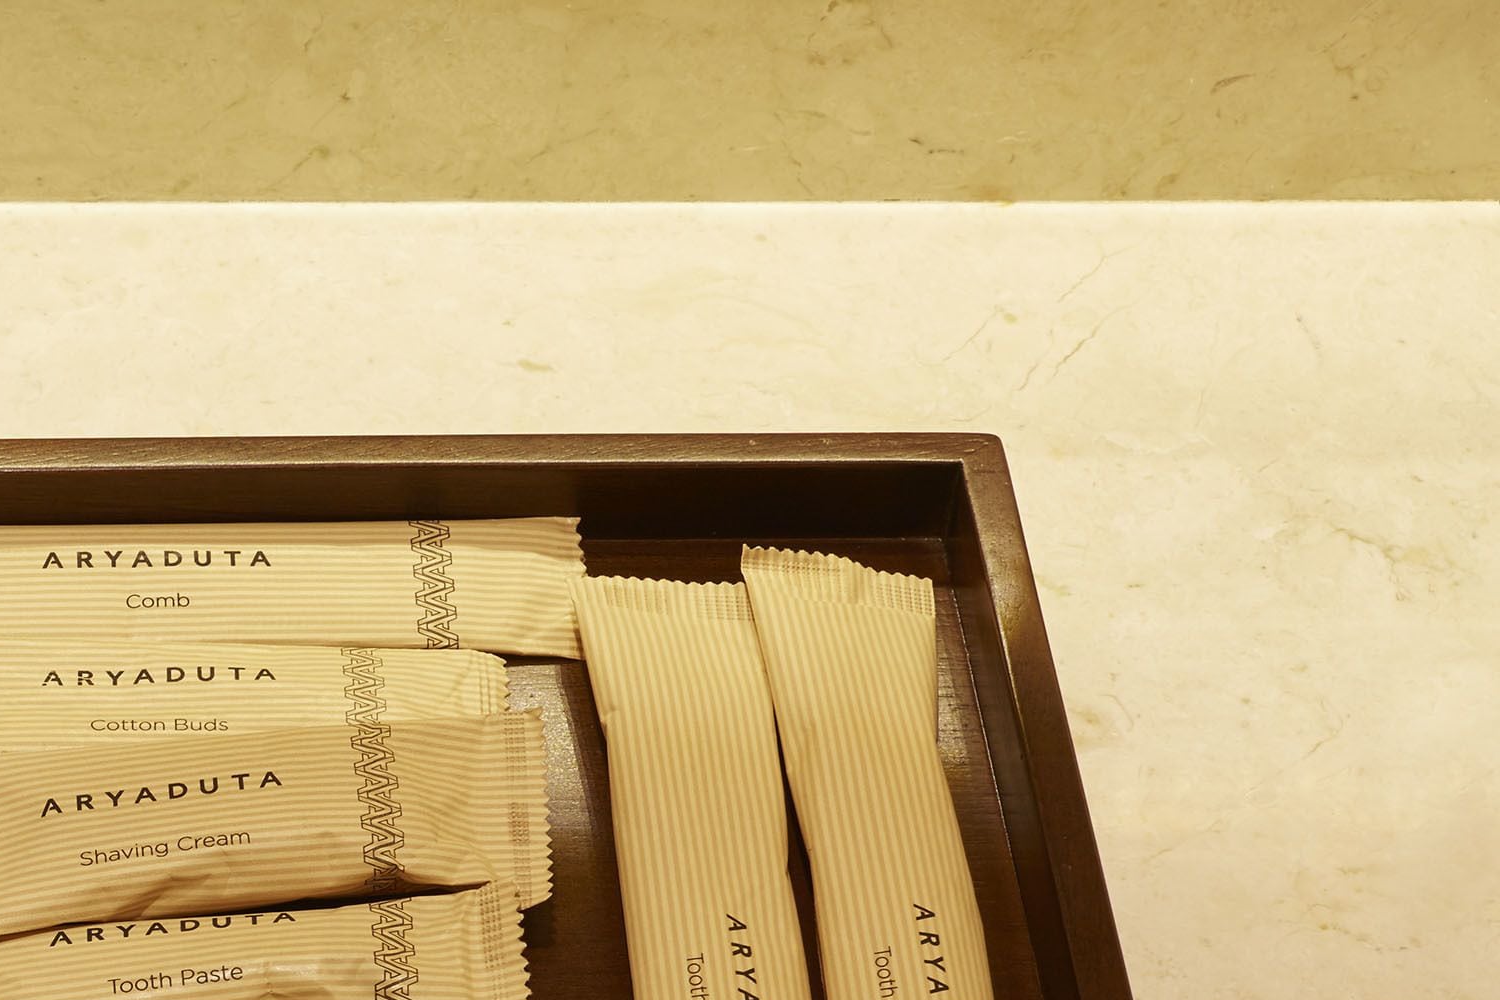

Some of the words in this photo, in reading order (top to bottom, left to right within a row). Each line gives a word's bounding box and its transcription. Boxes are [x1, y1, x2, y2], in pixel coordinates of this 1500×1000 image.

[42, 550, 272, 569] ARYADUTA
[125, 592, 190, 609] Comb
[42, 666, 276, 687] ARYADUTA
[90, 719, 166, 731] Cotton
[174, 718, 229, 732] Buds
[40, 771, 283, 818] ARYADUTA
[79, 842, 169, 867] Shaving
[177, 831, 251, 851] Cream
[49, 912, 296, 947] ARYADUTA
[107, 972, 173, 995] Tooth
[180, 965, 243, 986] Paste
[873, 945, 898, 999] Tooth
